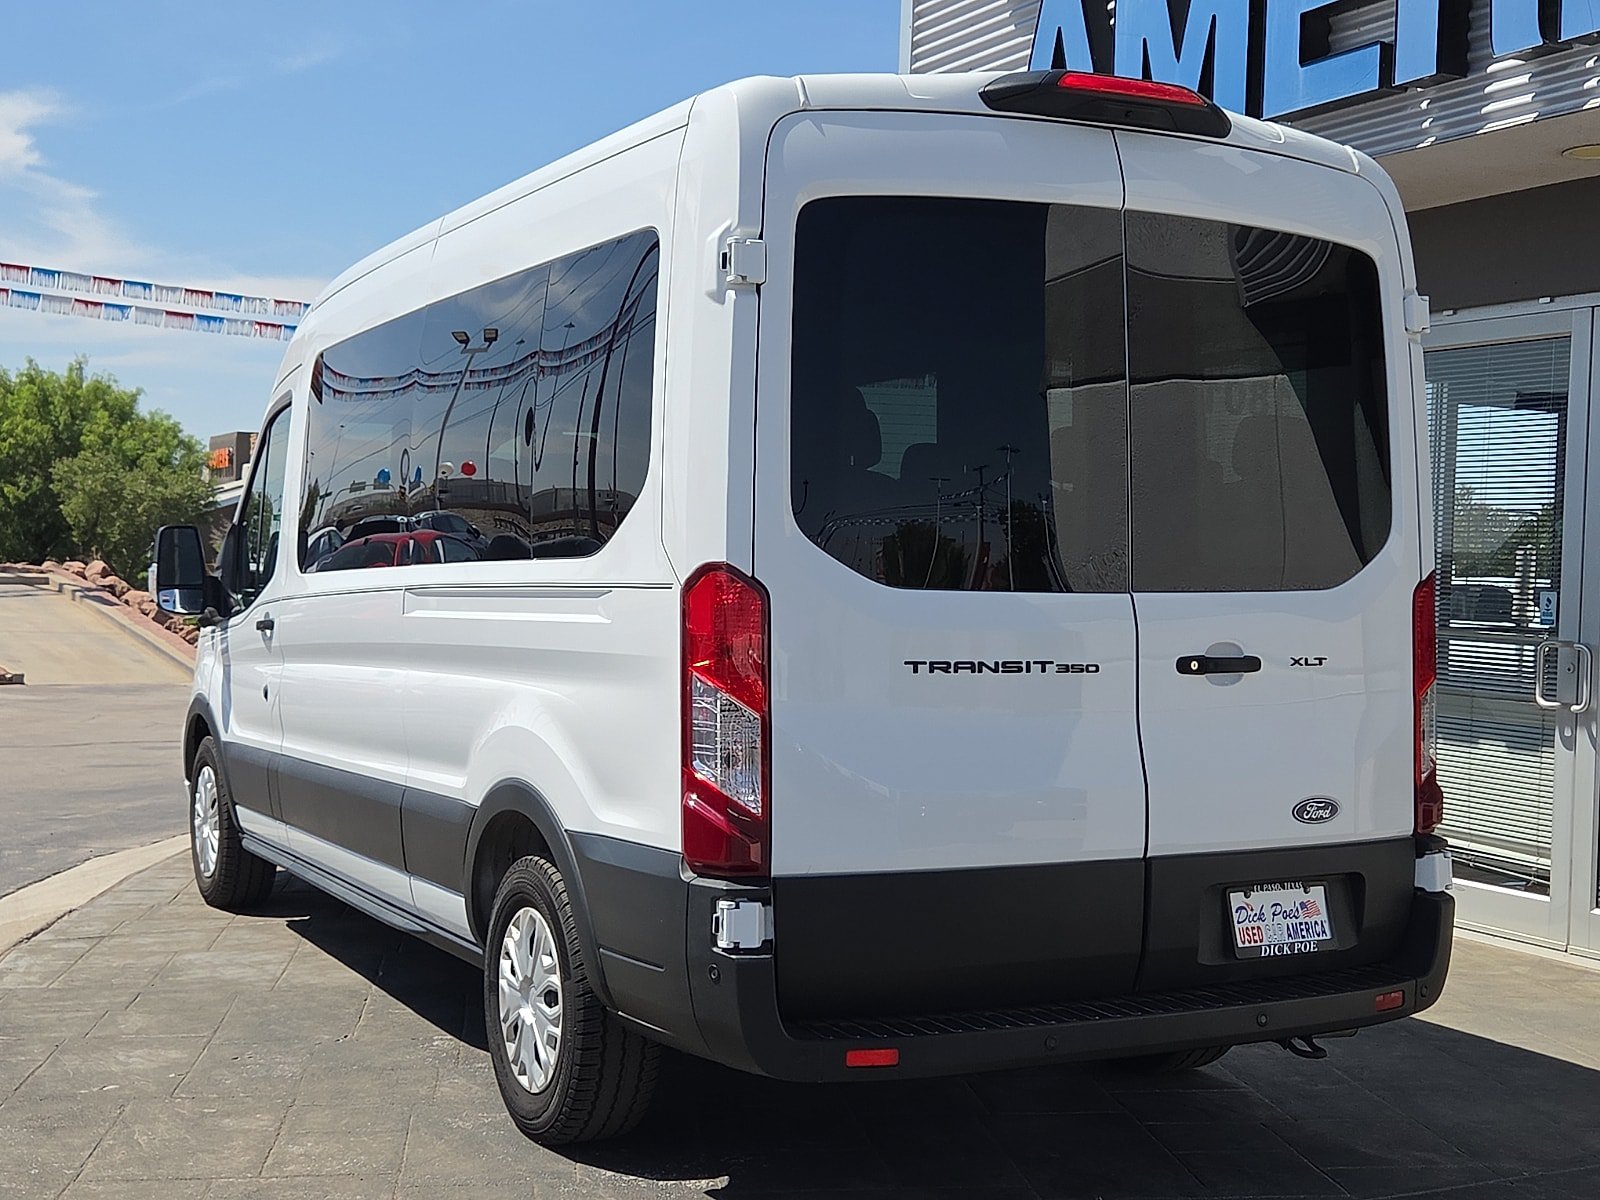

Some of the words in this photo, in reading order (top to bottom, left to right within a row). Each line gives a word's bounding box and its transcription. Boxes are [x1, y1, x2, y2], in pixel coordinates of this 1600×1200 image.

[903, 660, 1055, 674] TRANSIT
[1055, 663, 1100, 674] 350
[1289, 656, 1328, 667] XLT
[1303, 802, 1333, 820] Ford
[1235, 904, 1266, 925] Dick
[1270, 900, 1301, 922] Poe's
[1238, 926, 1264, 945] USED
[1286, 919, 1328, 941] AMERICA
[1261, 943, 1292, 957] DICK
[1294, 941, 1318, 953] POE
